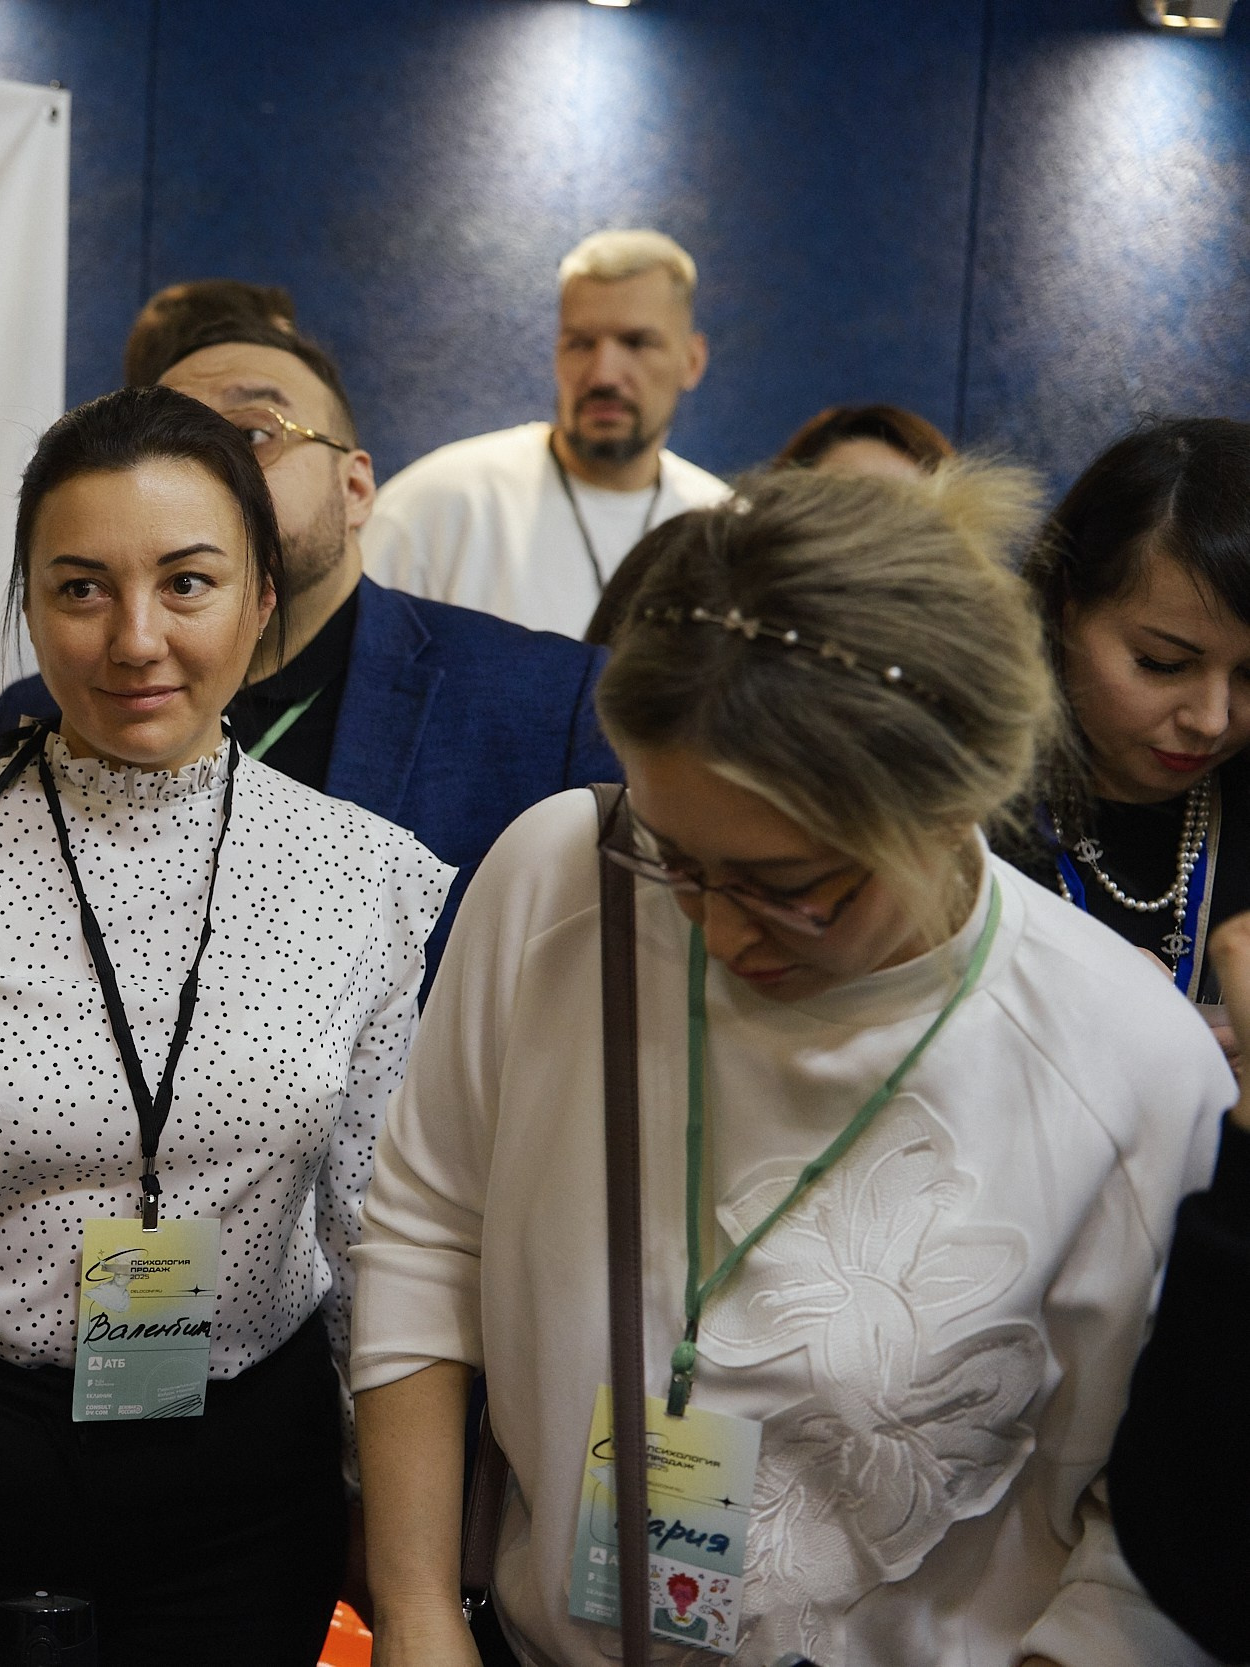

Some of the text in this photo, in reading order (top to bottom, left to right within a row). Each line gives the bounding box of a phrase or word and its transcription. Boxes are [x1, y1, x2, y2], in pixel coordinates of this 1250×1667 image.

[104, 1358, 126, 1369] АТБ
[647, 1444, 721, 1468] ПСИХОЛОГИЯ
[614, 1508, 730, 1556] ария
